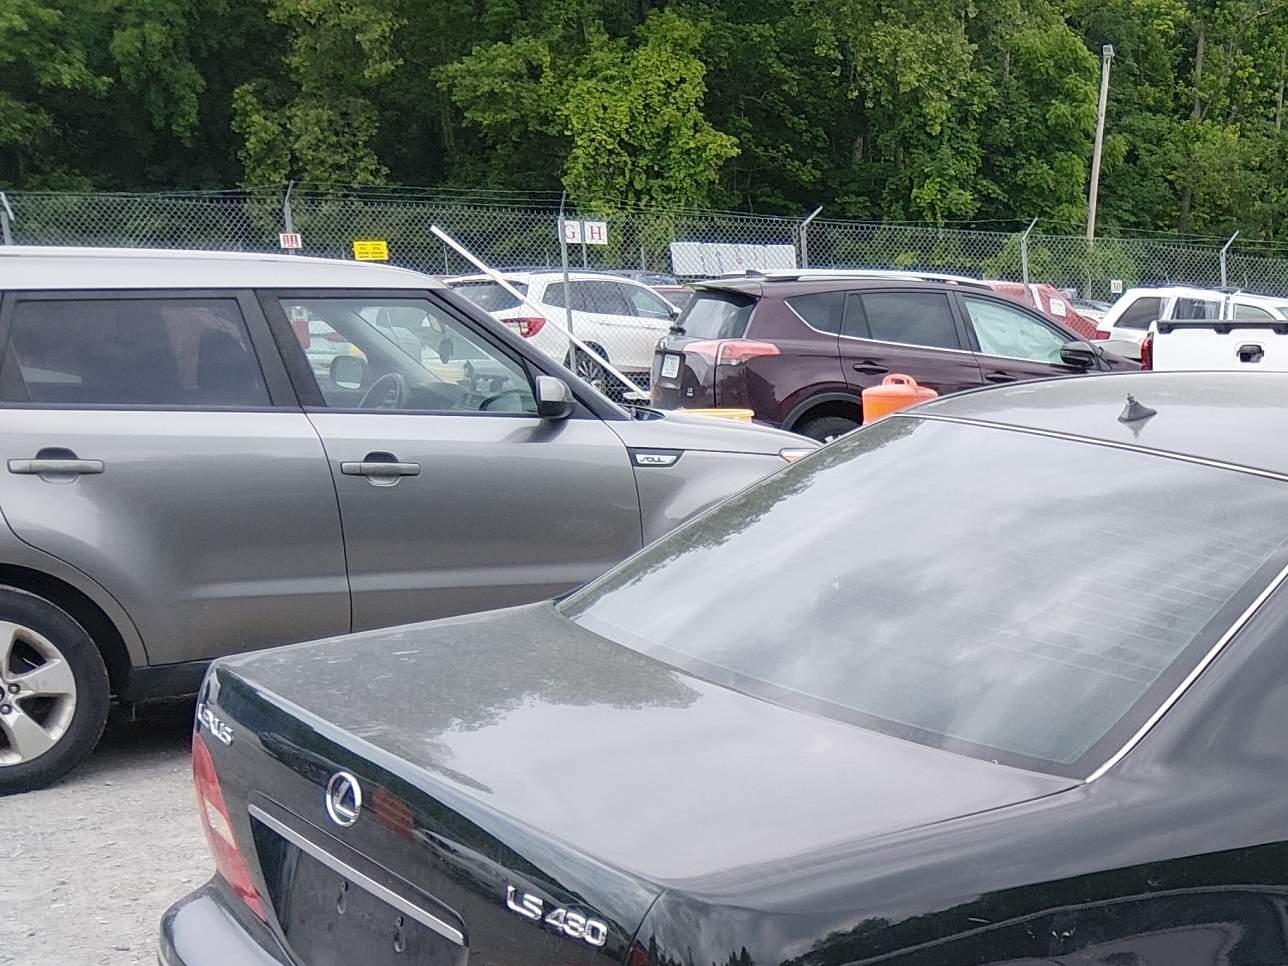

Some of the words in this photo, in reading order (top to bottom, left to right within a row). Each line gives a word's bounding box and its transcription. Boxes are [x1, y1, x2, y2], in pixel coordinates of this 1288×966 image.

[564, 224, 576, 239] G
[589, 225, 602, 240] H
[198, 703, 233, 745] LEXUS
[507, 885, 543, 920] LS
[545, 908, 608, 946] 430
